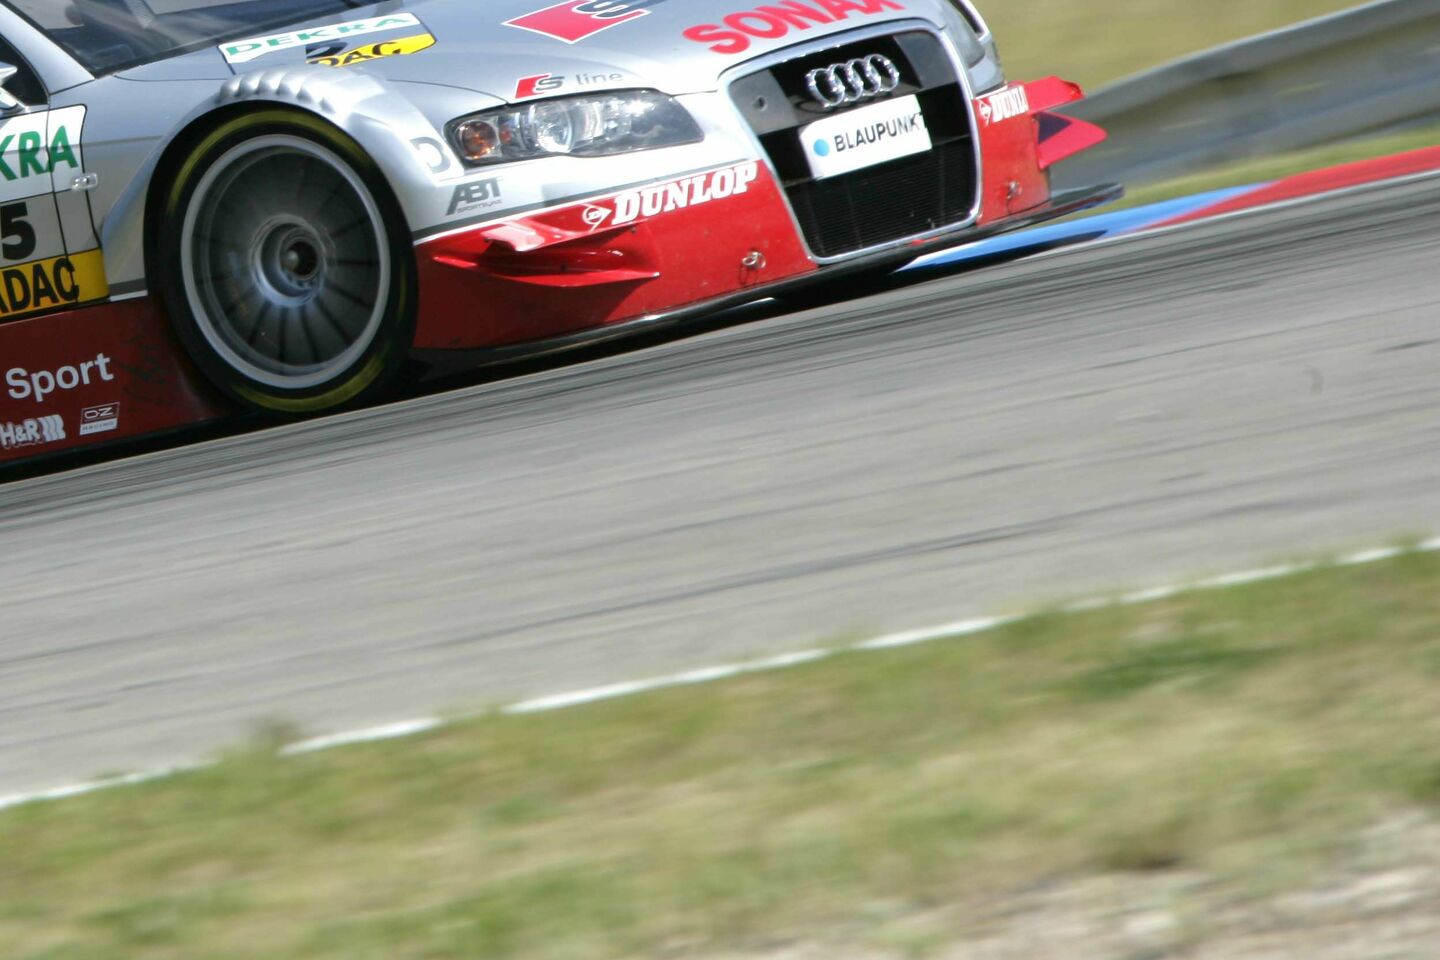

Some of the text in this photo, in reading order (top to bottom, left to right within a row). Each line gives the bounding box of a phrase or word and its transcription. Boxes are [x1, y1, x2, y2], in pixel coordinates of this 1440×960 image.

[226, 17, 410, 56] DEKRA
[576, 73, 624, 86] line
[446, 177, 502, 216] ABT
[611, 161, 758, 226] DUNLOP
[5, 352, 115, 403] Sport
